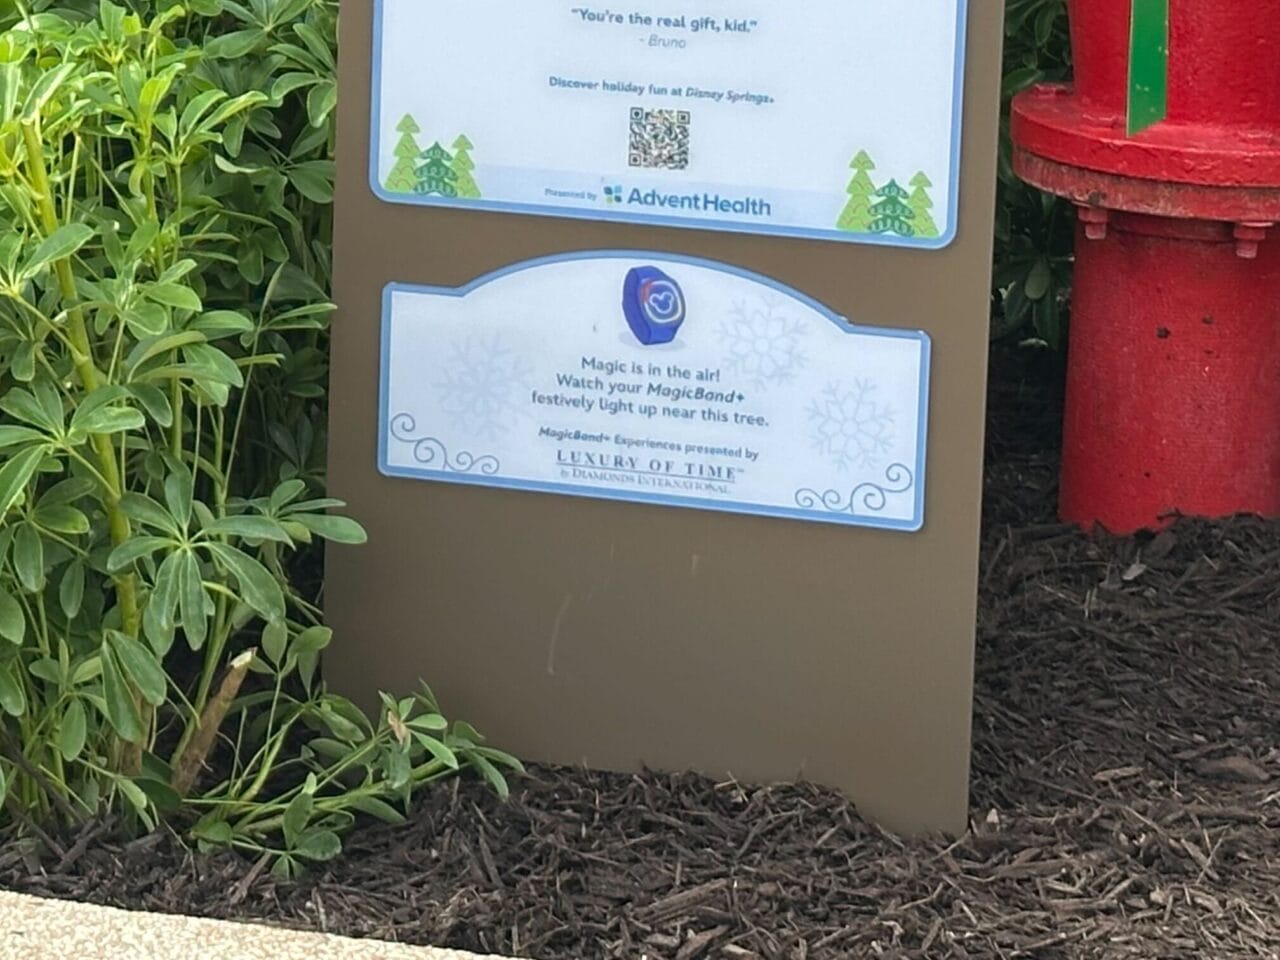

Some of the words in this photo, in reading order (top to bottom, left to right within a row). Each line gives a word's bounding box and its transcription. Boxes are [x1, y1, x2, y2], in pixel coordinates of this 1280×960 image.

[628, 11, 653, 26] the
[656, 14, 686, 29] real
[690, 16, 721, 33] gift,
[648, 34, 687, 49] Bruno
[548, 75, 599, 90] Discover
[602, 79, 645, 96] holiday
[648, 84, 668, 95] fun
[671, 86, 682, 97] at
[685, 87, 724, 103] Disney
[627, 187, 772, 216] AdventHealth
[581, 356, 627, 376] Magic
[631, 361, 643, 375] is
[647, 363, 662, 377] in
[666, 364, 691, 379] the
[695, 368, 721, 382] air!
[556, 373, 604, 390] Watch
[608, 380, 643, 395] your
[646, 382, 745, 404] MagicBand+
[531, 391, 595, 412] festively
[599, 397, 633, 415] light
[638, 404, 658, 419] up
[662, 405, 696, 420] near
[701, 408, 729, 423] this
[733, 411, 770, 427] tree.
[556, 449, 639, 470] LUXURY
[649, 458, 675, 473] OF
[614, 434, 682, 452] Experiences
[684, 443, 742, 458] presented
[745, 447, 759, 462] by
[572, 468, 635, 484] DIAMONDS
[637, 474, 732, 493] INTERNATIONAL
